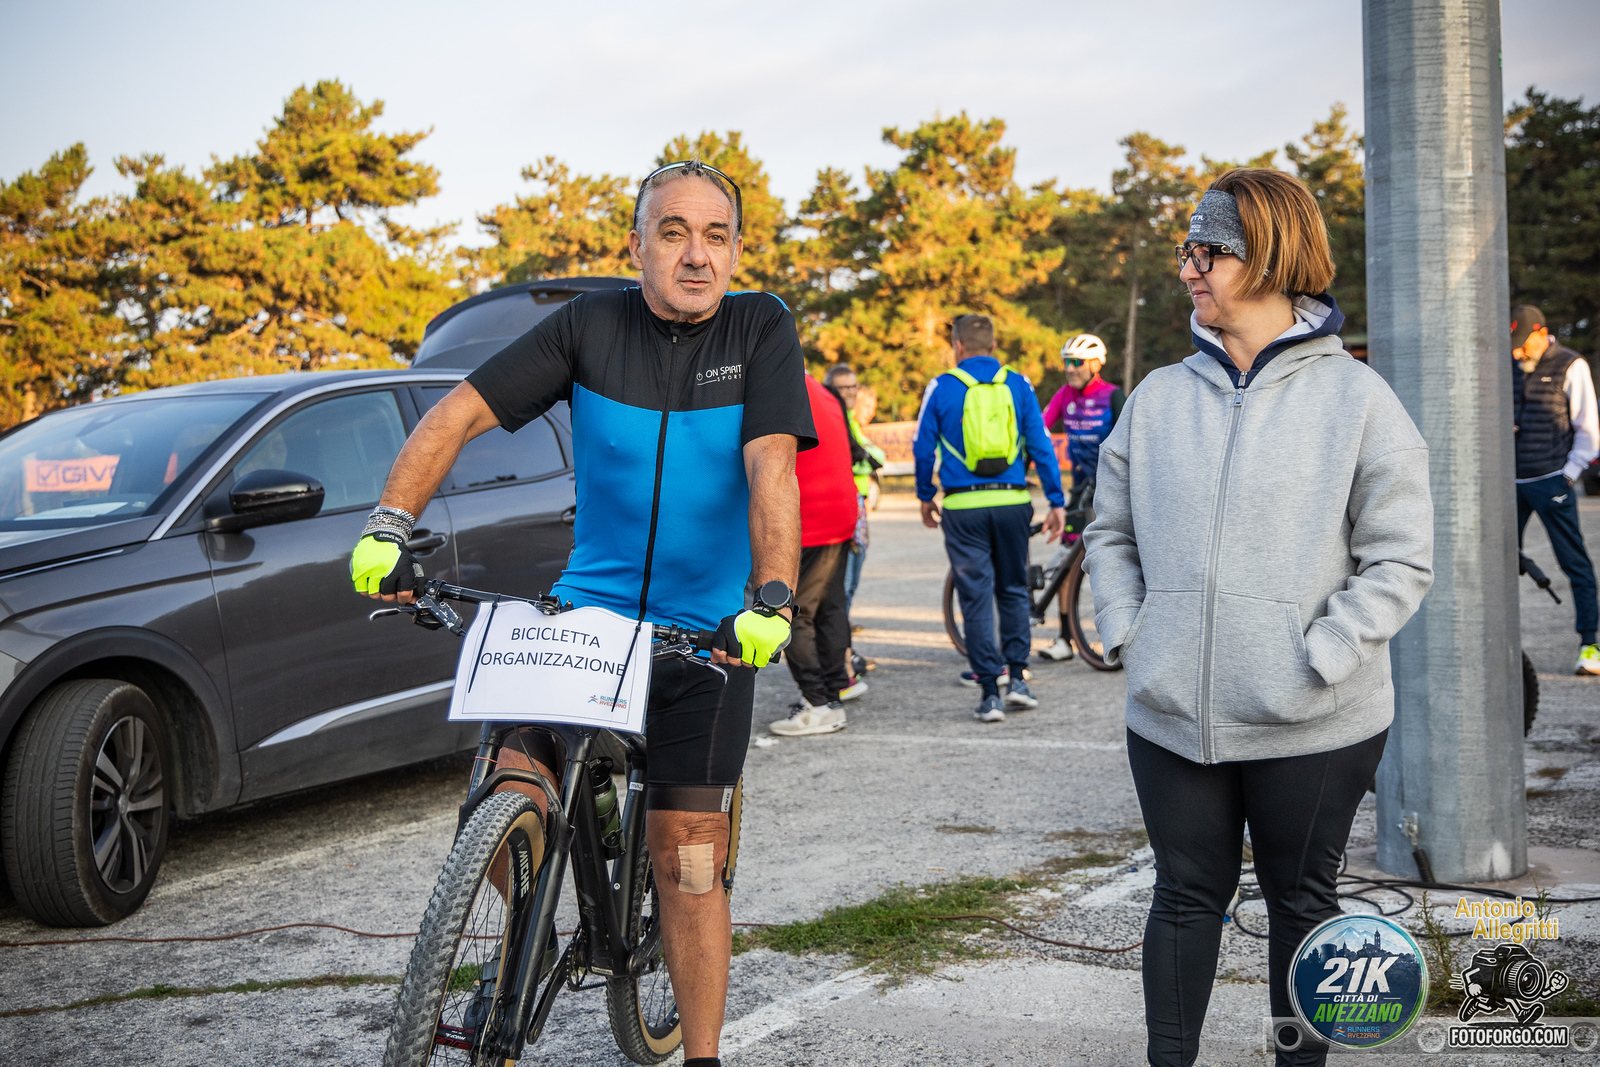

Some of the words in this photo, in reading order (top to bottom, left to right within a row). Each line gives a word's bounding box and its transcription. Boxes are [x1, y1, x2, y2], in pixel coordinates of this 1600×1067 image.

[705, 369, 719, 378] ON
[720, 364, 742, 376] SPIRIT
[717, 373, 742, 381] SPORT
[511, 627, 601, 648] BICICLETTA
[480, 652, 626, 677] ORGANIZZAZIONE
[600, 695, 628, 704] RUNERS
[518, 850, 530, 898] MICHE
